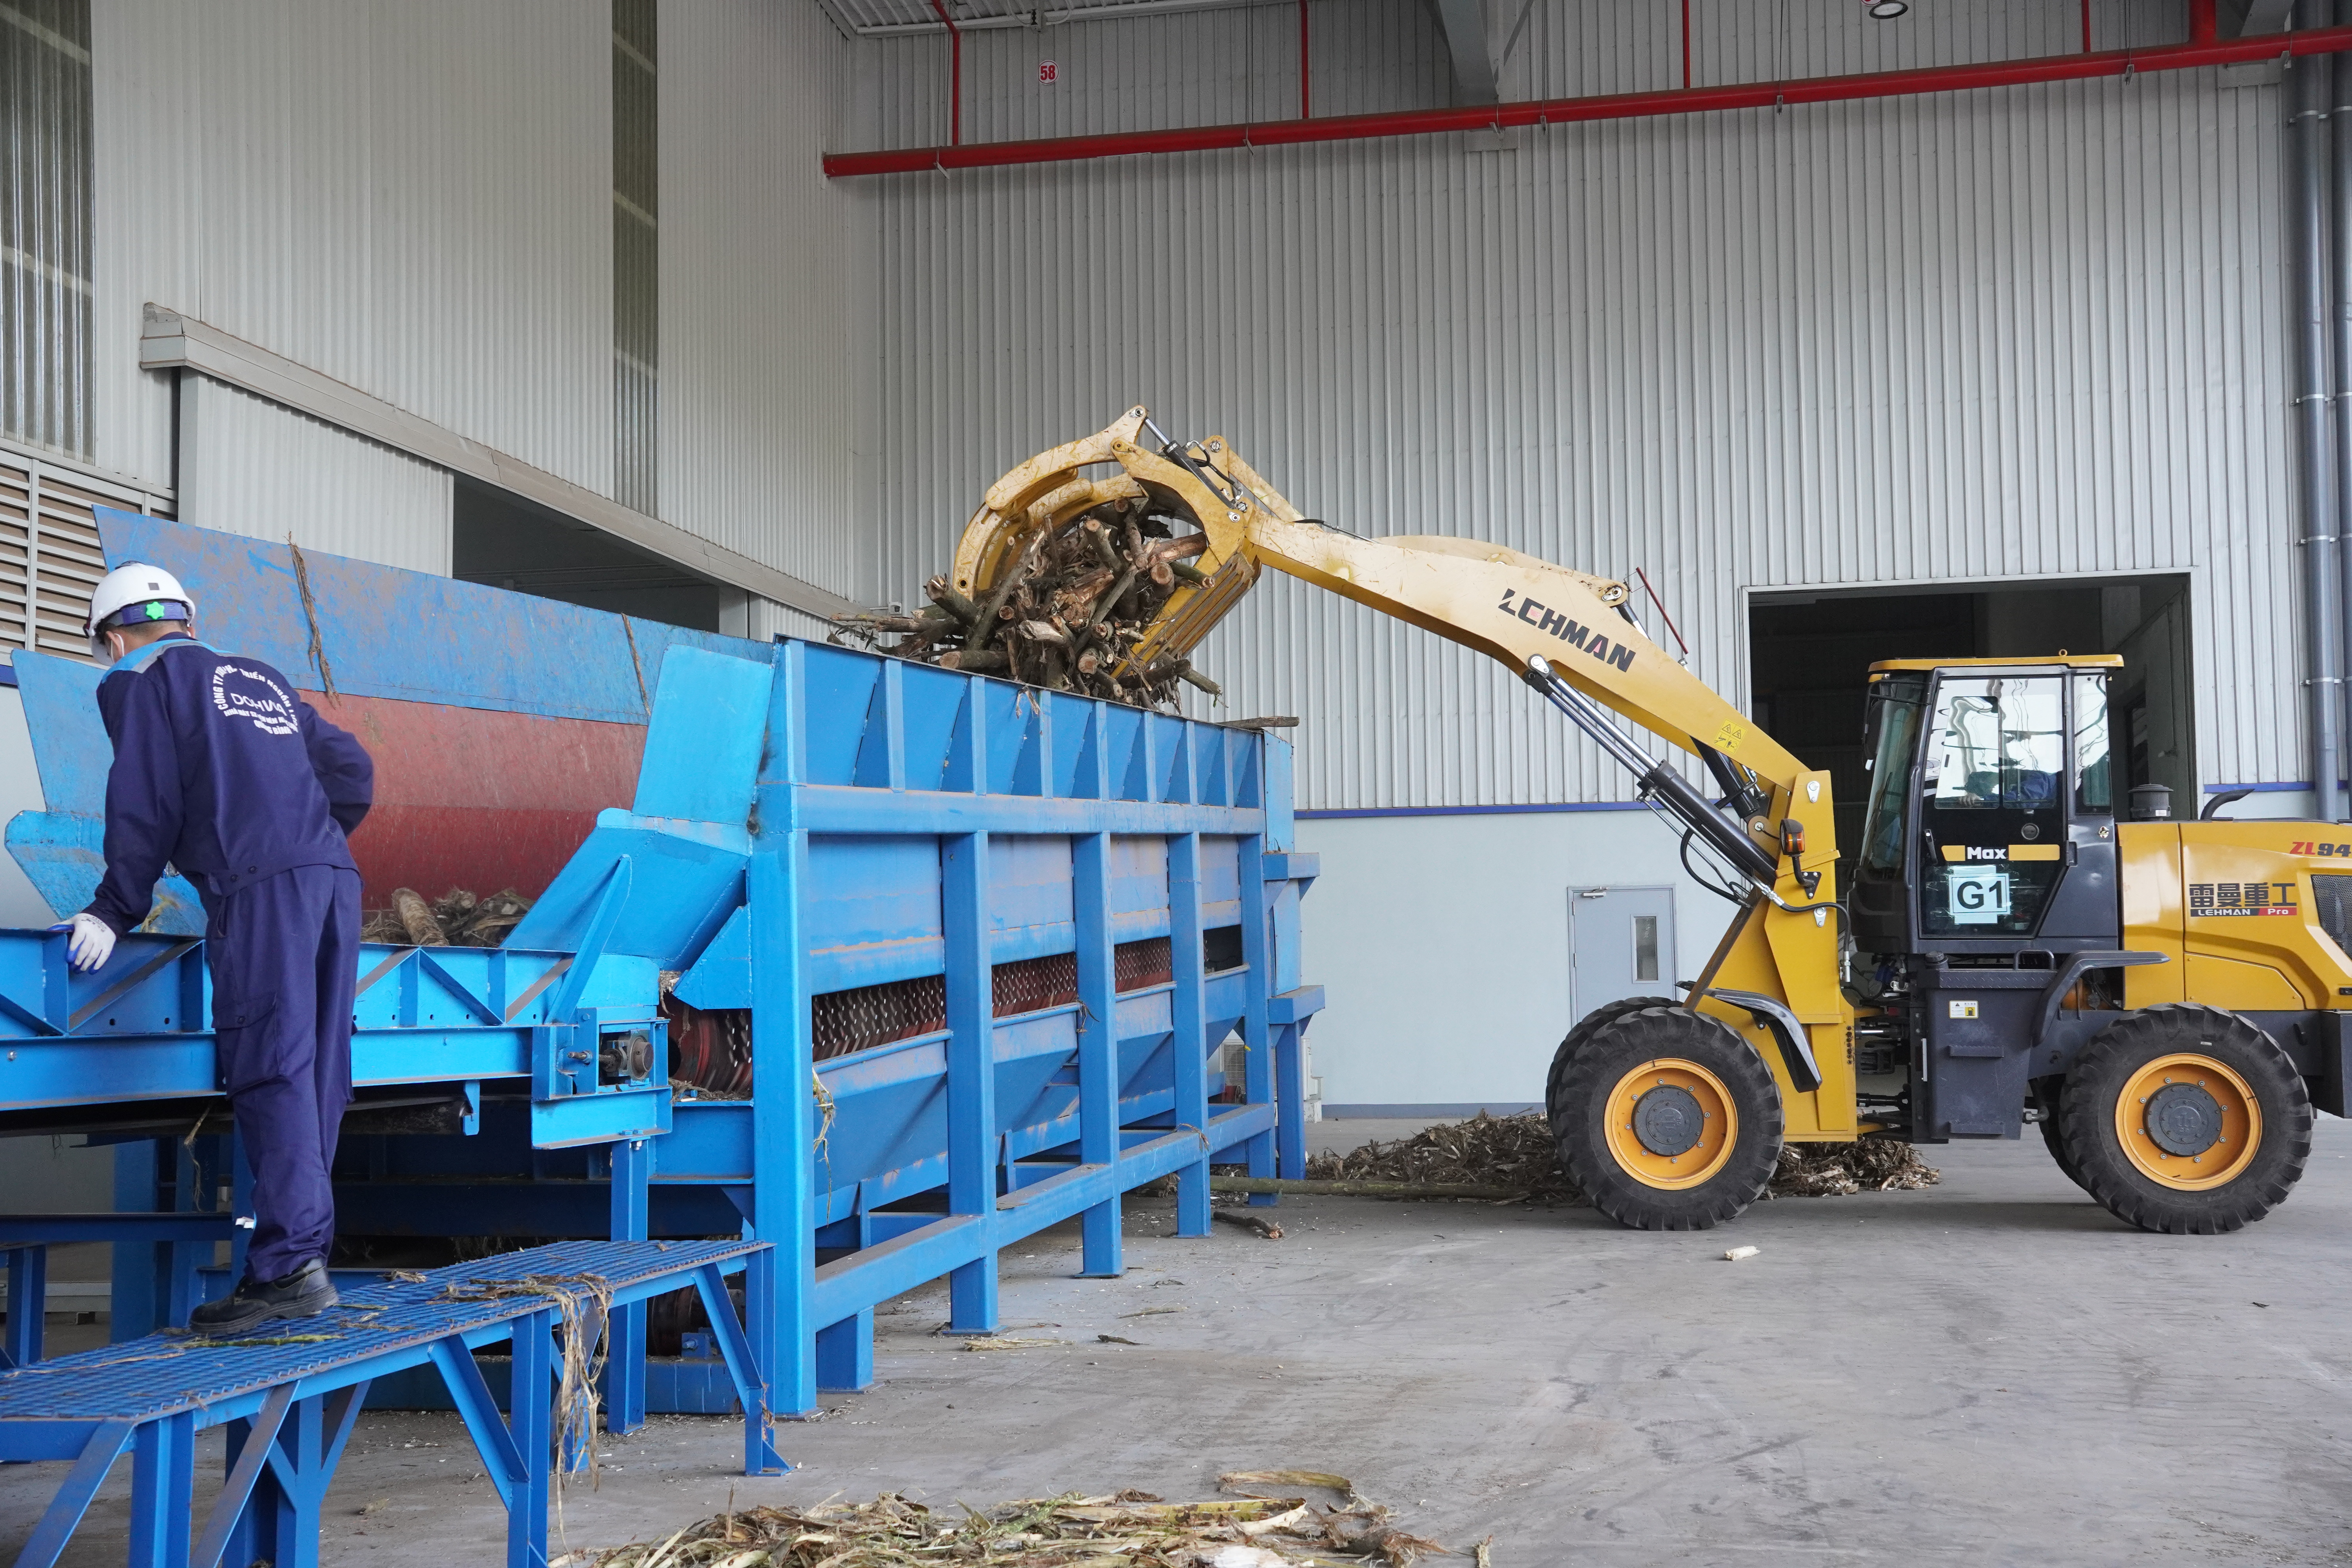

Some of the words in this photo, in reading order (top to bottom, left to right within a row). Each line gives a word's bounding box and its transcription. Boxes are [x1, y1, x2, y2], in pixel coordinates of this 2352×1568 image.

[1040, 65, 1055, 80] 58
[1498, 588, 1636, 673] LEHMAN
[213, 674, 223, 685] TY
[213, 686, 229, 710] CÔNG
[230, 693, 288, 716] DOHWA
[1967, 847, 2007, 859] Max
[2290, 841, 2352, 857] ZL94
[1957, 880, 2003, 909] G1
[2189, 882, 2297, 907] 雷曼重工
